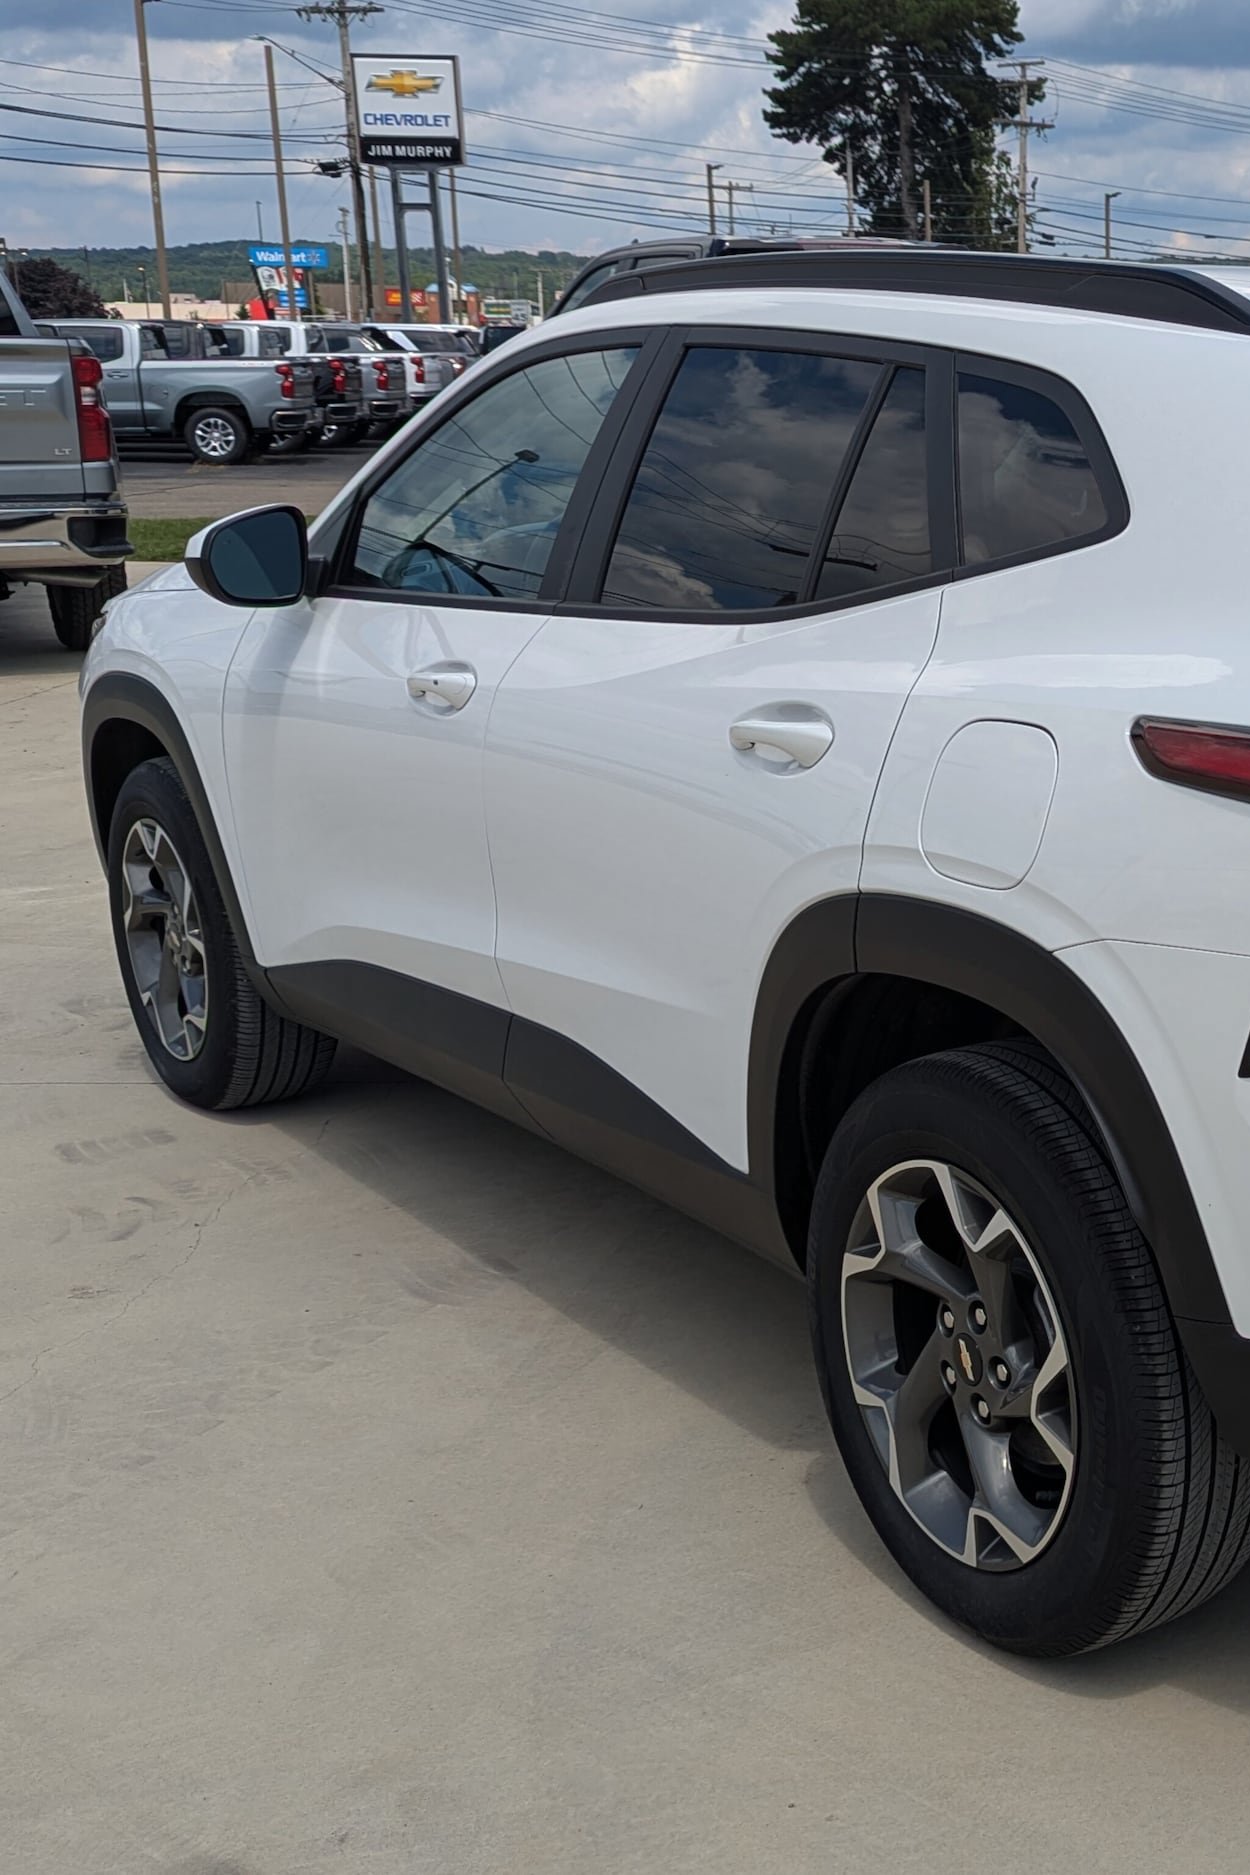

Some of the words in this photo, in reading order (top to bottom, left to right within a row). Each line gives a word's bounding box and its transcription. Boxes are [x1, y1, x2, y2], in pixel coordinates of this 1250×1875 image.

[363, 113, 451, 127] CHEVROLET
[368, 145, 393, 156] JIM
[394, 145, 452, 158] MURPHY
[54, 448, 72, 456] LT
